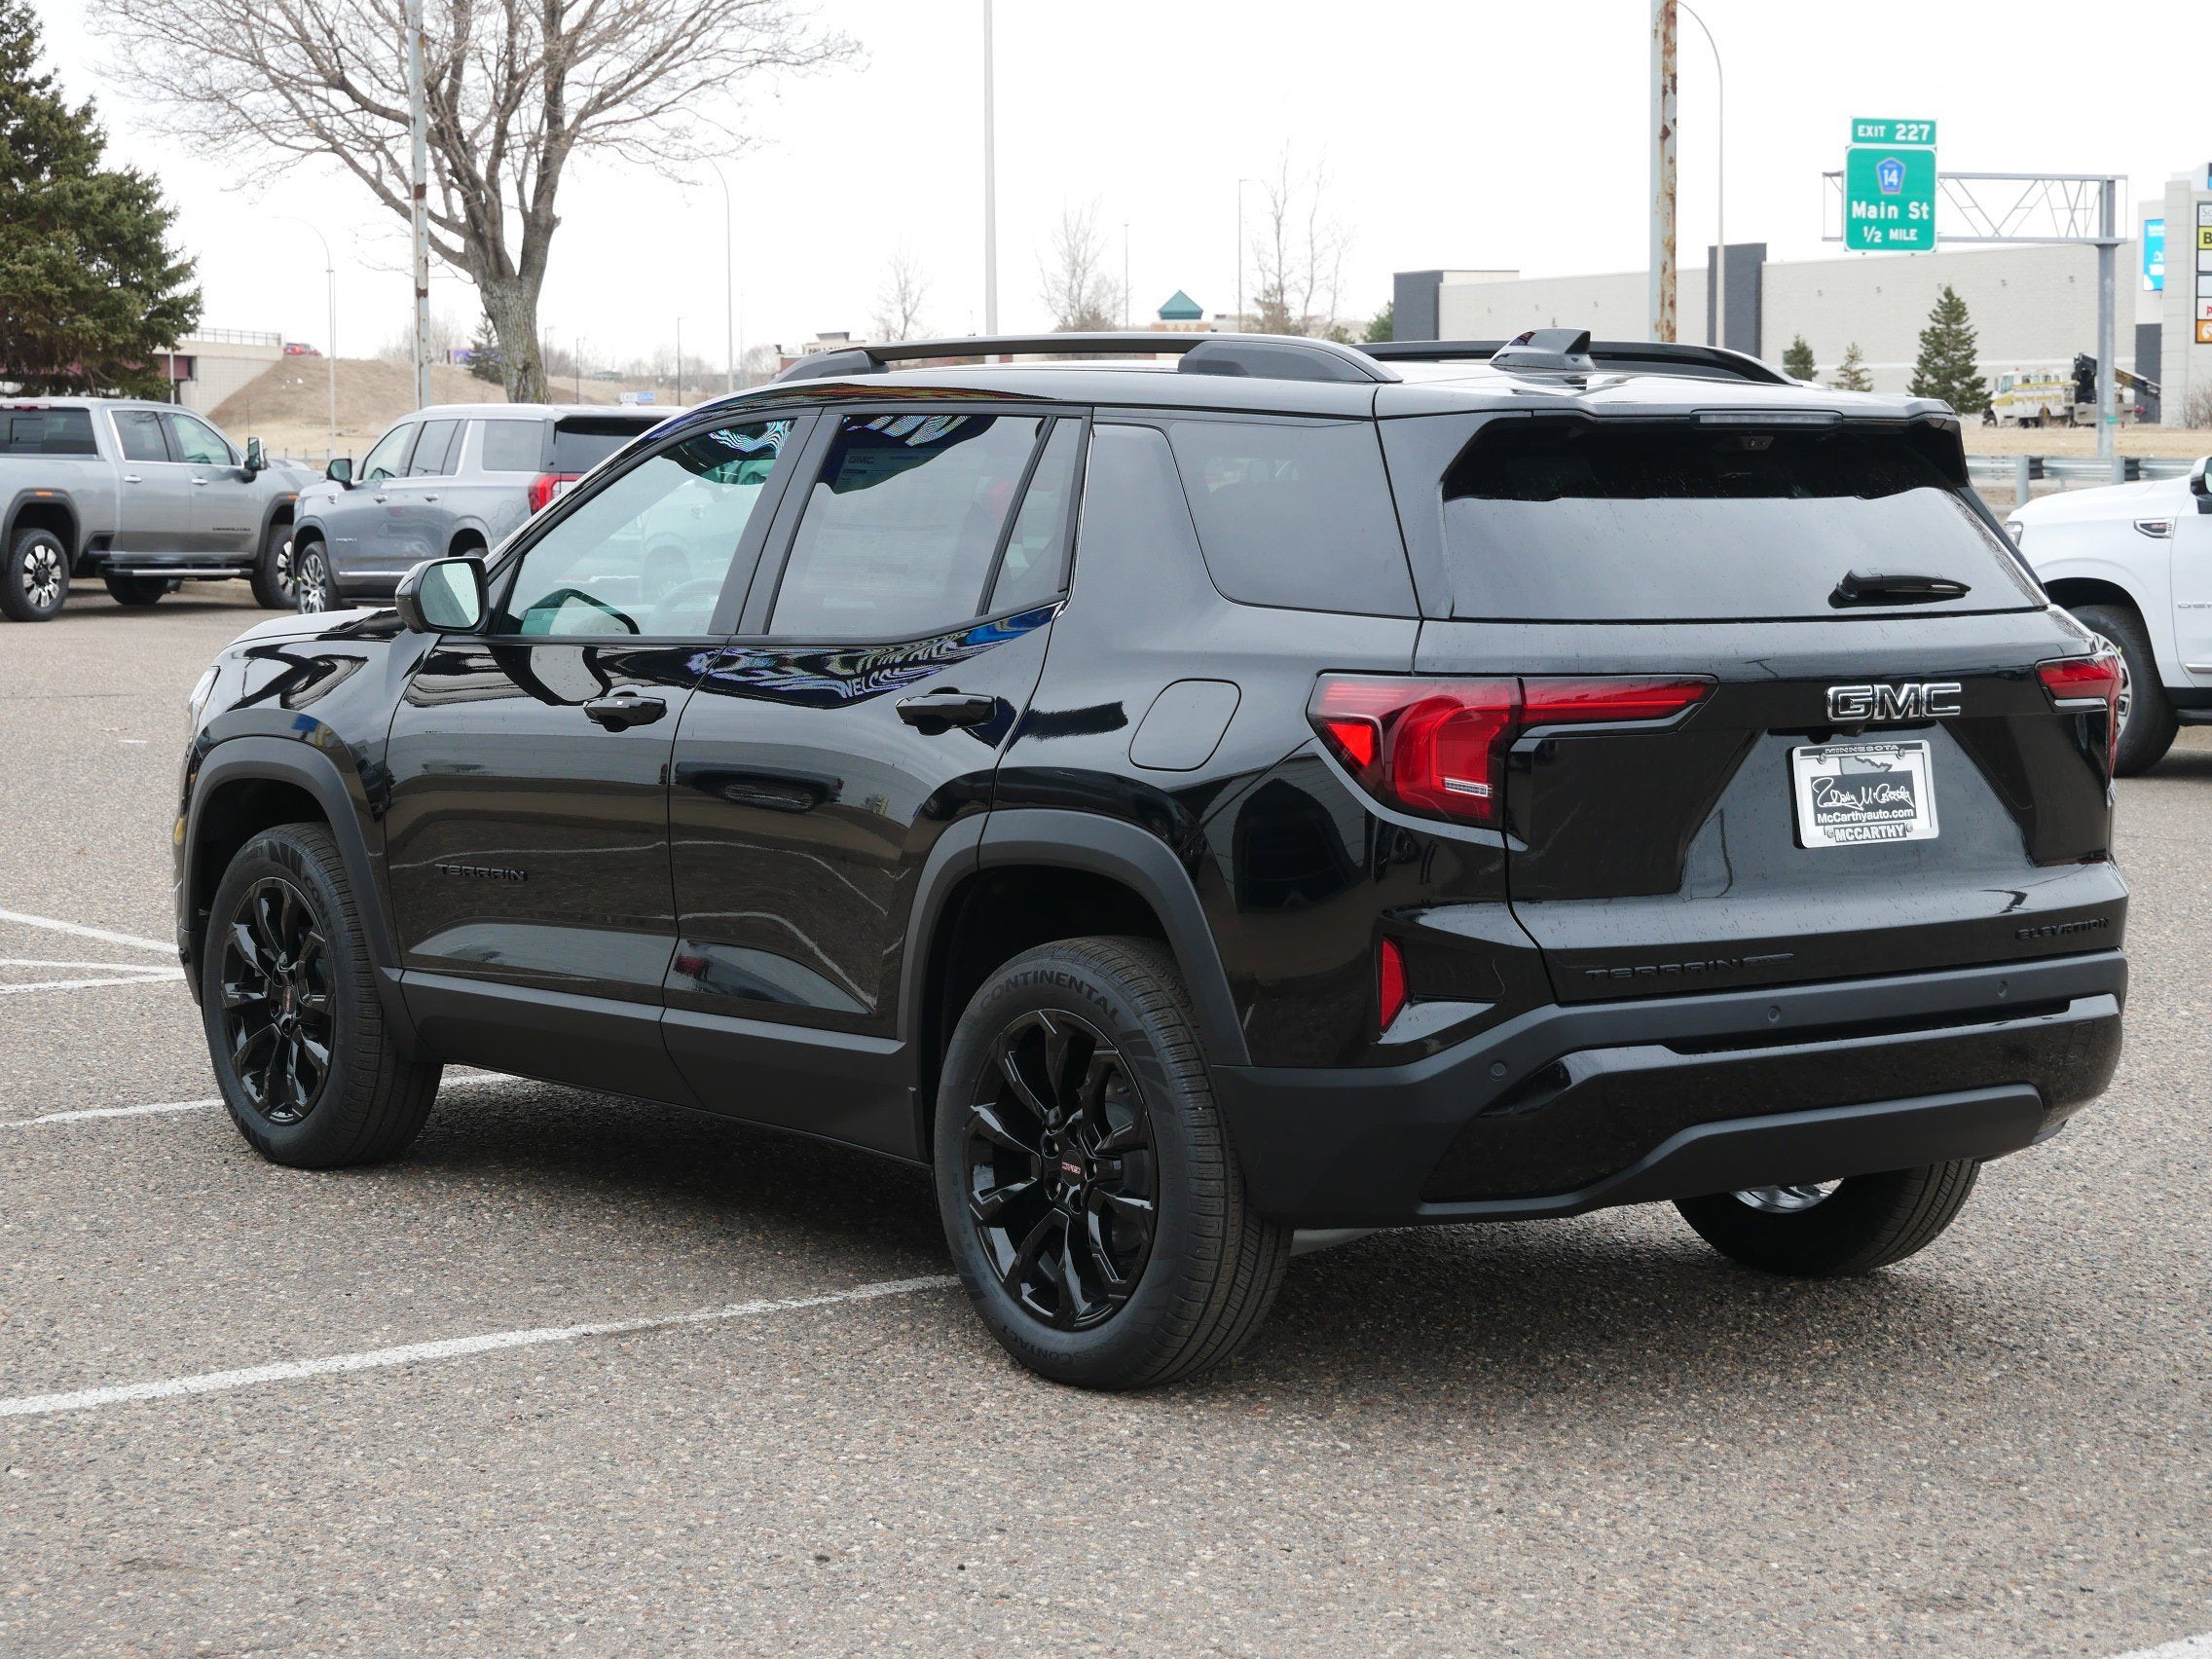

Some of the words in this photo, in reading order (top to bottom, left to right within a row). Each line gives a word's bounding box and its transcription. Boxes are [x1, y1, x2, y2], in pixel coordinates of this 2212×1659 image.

[1857, 125, 1886, 137] EXIT
[1895, 124, 1931, 141] 227
[1883, 168, 1899, 186] 14
[1852, 200, 1899, 219] Main
[1908, 201, 1930, 220] St
[1890, 228, 1918, 241] MILE
[1825, 682, 1962, 721] GMC
[1825, 744, 1899, 755] MINNESOTA
[1817, 808, 1914, 825] McCarthyauto.com
[1834, 825, 1905, 843] MCCARTHY
[434, 863, 529, 882] TERRAIN
[1584, 957, 1738, 980] TERRAIN
[980, 970, 1120, 1027] CONTINENTAL
